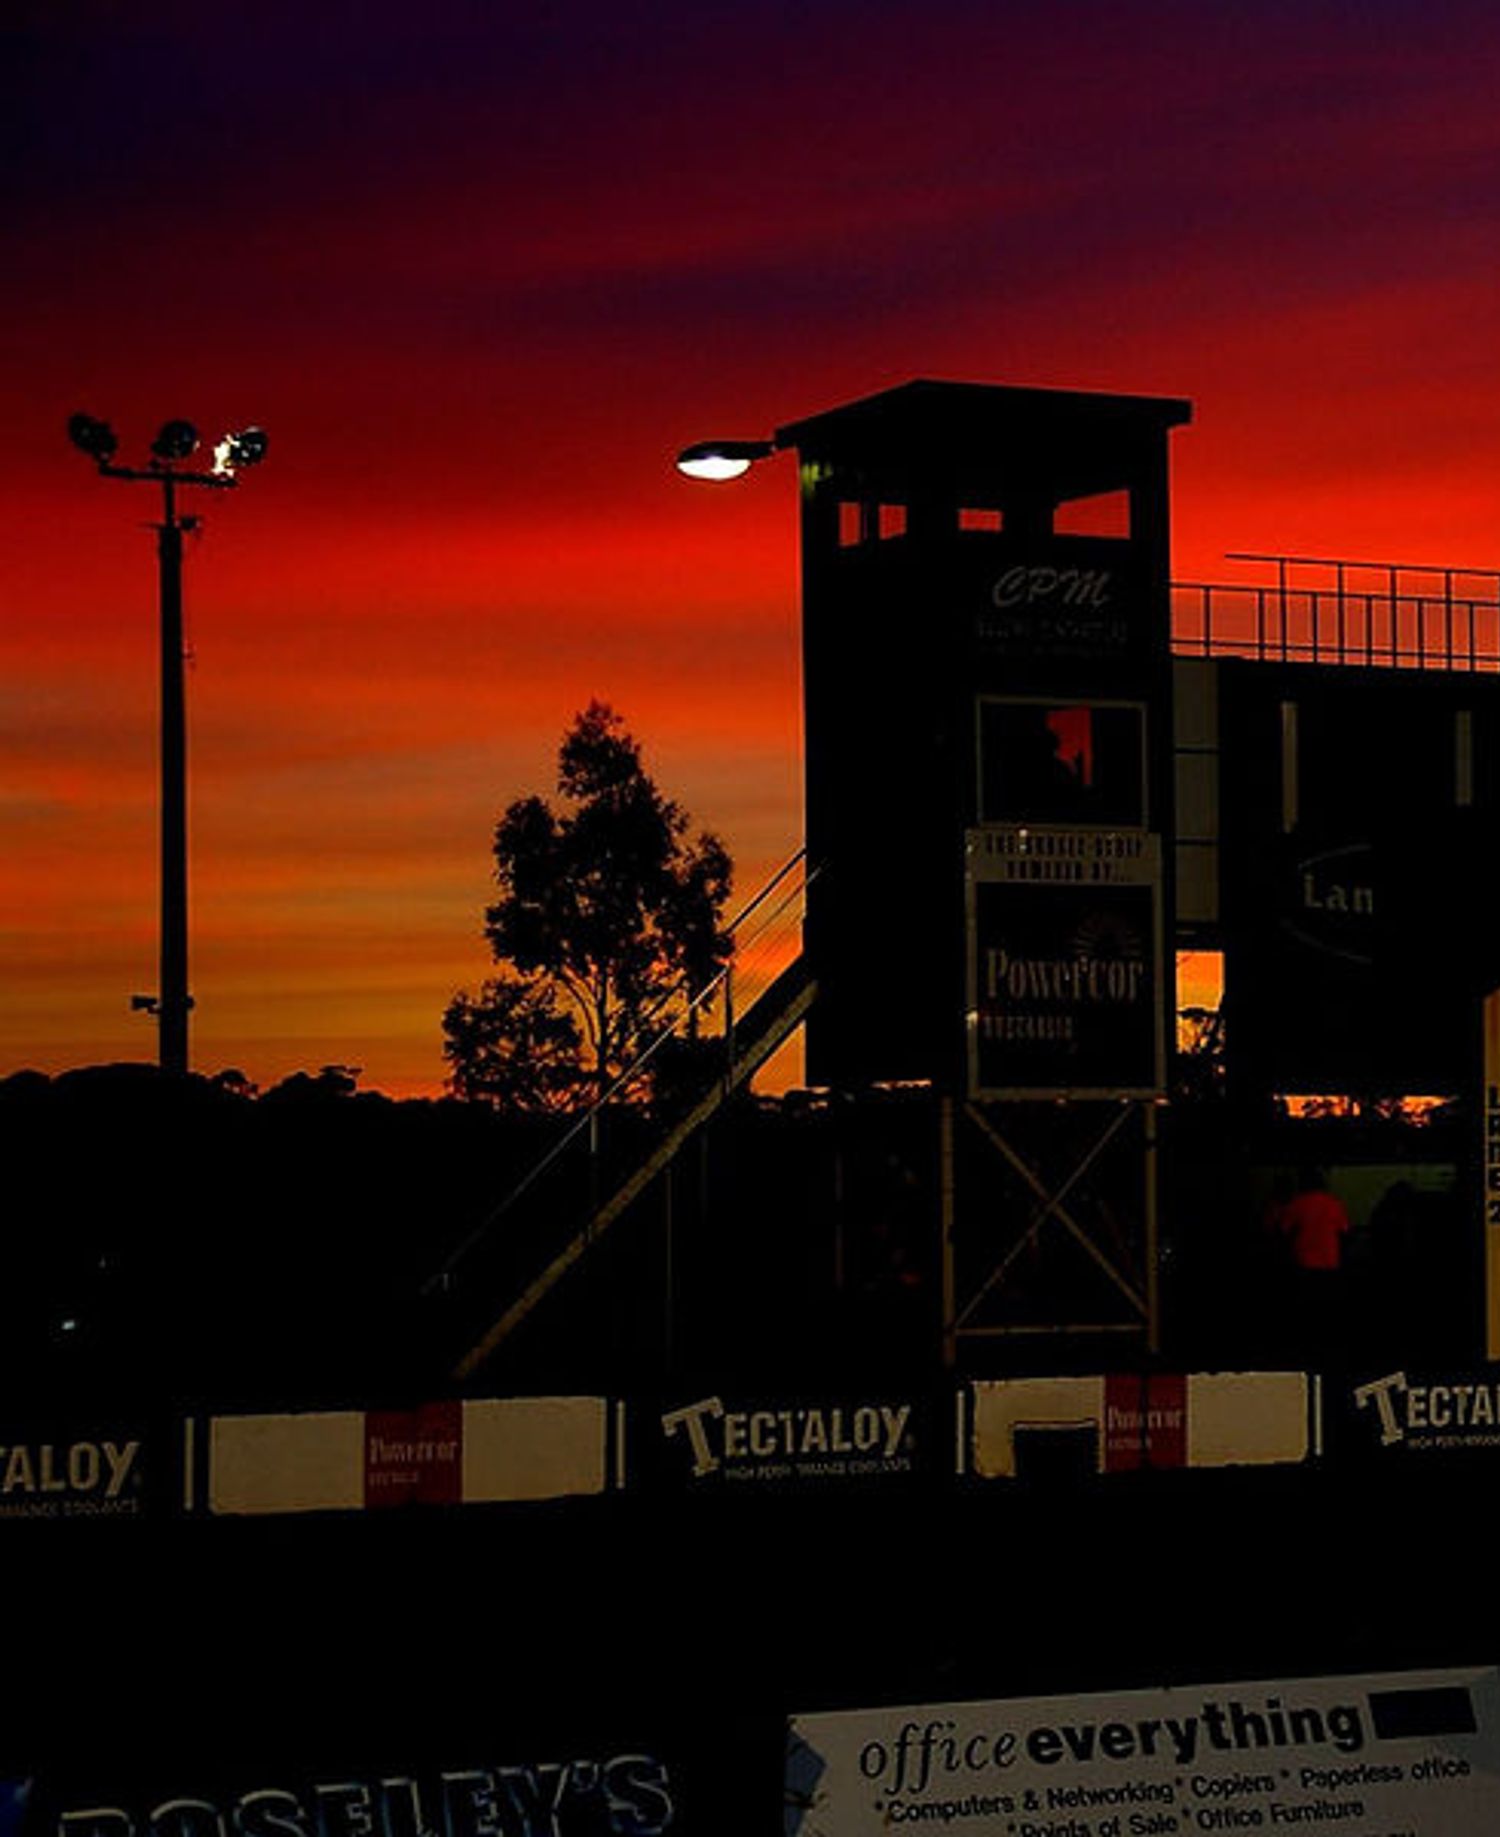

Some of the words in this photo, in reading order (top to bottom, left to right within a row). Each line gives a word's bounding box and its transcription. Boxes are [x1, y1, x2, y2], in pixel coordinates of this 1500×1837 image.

[992, 564, 1112, 608] CPM
[985, 948, 1145, 1001] Powercor
[661, 1395, 912, 1477] TECTALOY
[0, 1441, 141, 1497] ALOY
[859, 1720, 1018, 1796] office
[1026, 1694, 1365, 1766] everything
[1024, 1789, 1039, 1811] &
[1047, 1779, 1174, 1810] Networking
[1190, 1772, 1276, 1801] Copiers
[1300, 1763, 1405, 1791] Paperless
[1410, 1757, 1471, 1781] office
[1128, 1811, 1178, 1836] Sale
[1197, 1806, 1263, 1830] Office
[1270, 1799, 1365, 1824] Furniture
